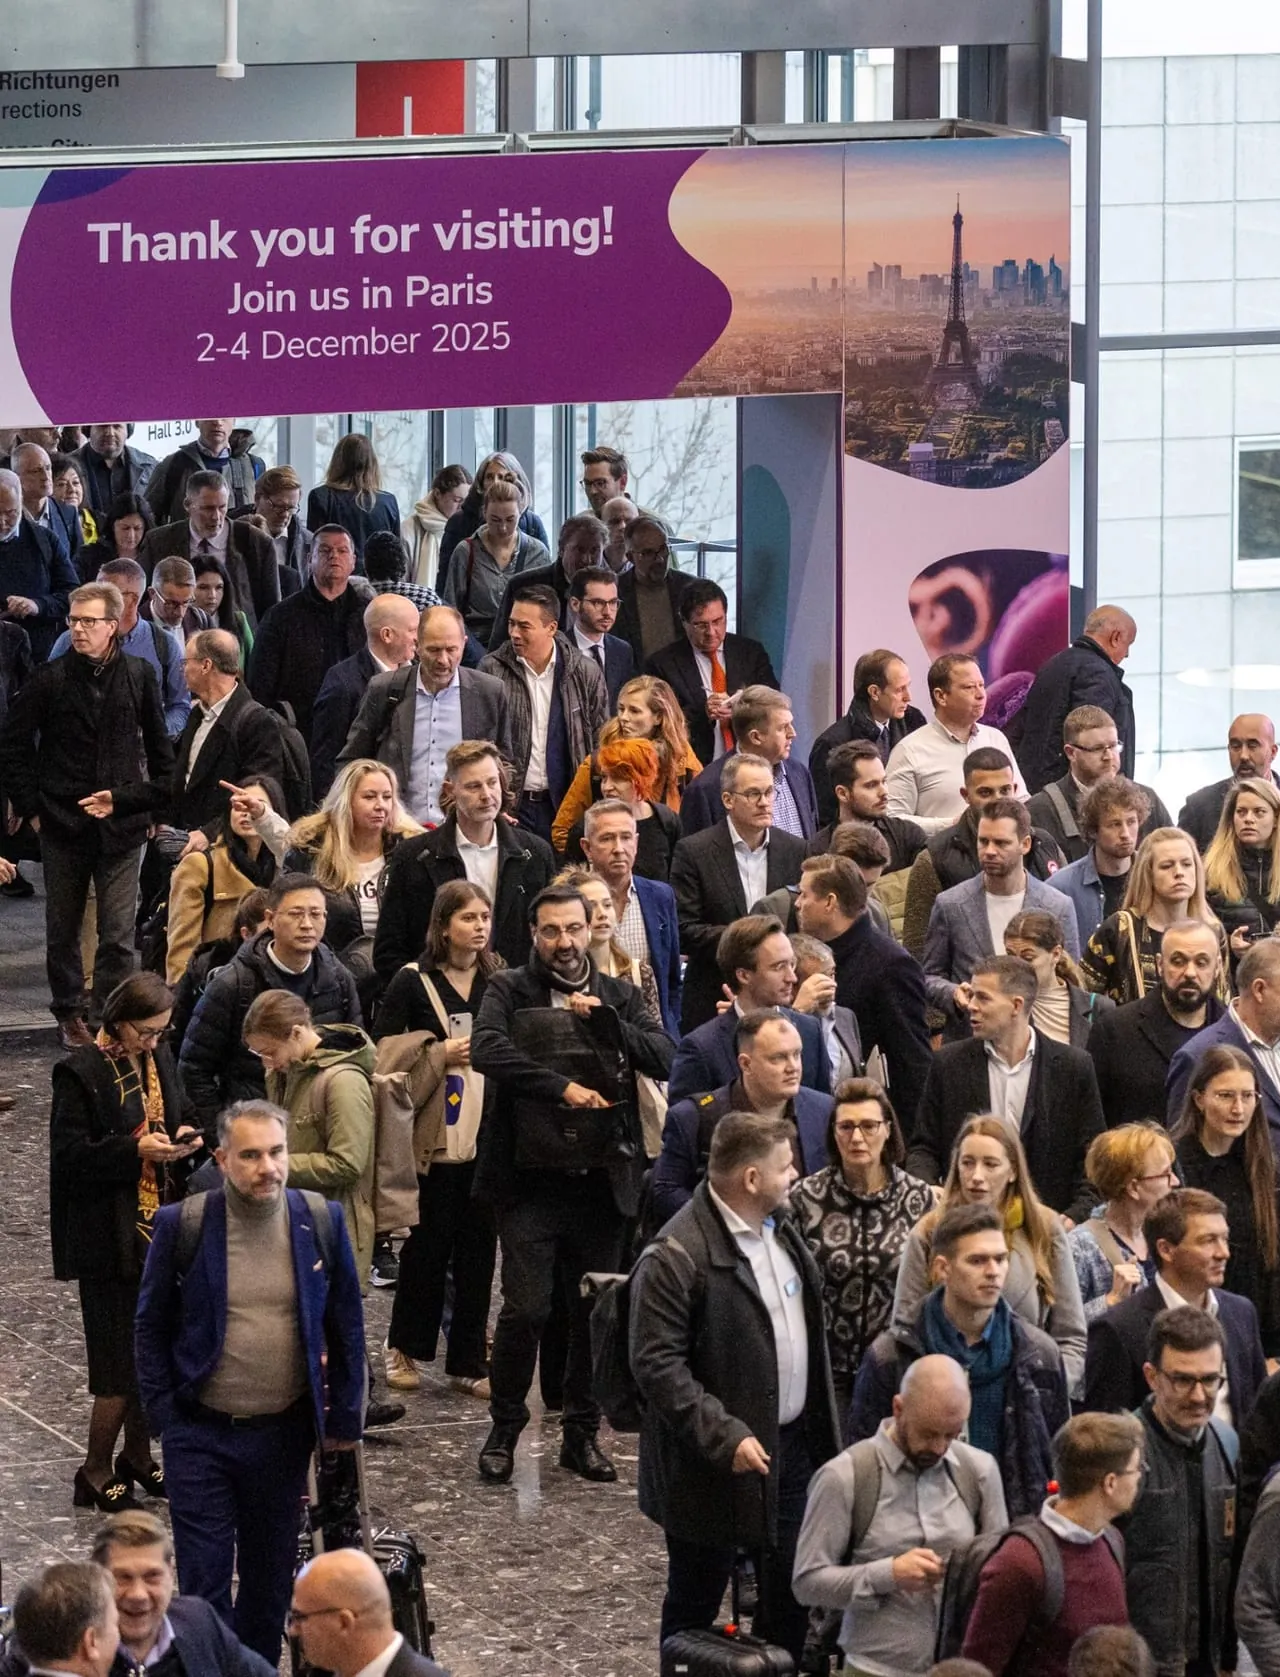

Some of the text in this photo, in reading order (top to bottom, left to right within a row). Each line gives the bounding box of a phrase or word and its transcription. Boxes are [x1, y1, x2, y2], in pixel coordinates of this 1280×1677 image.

[0, 71, 119, 93] Richtungen
[2, 99, 82, 119] rections
[87, 205, 613, 268] Thank you for visiting!
[228, 273, 493, 315] Join us in Paris
[196, 321, 511, 362] 2-4 December 2025
[148, 420, 192, 441] Hall 3.0
